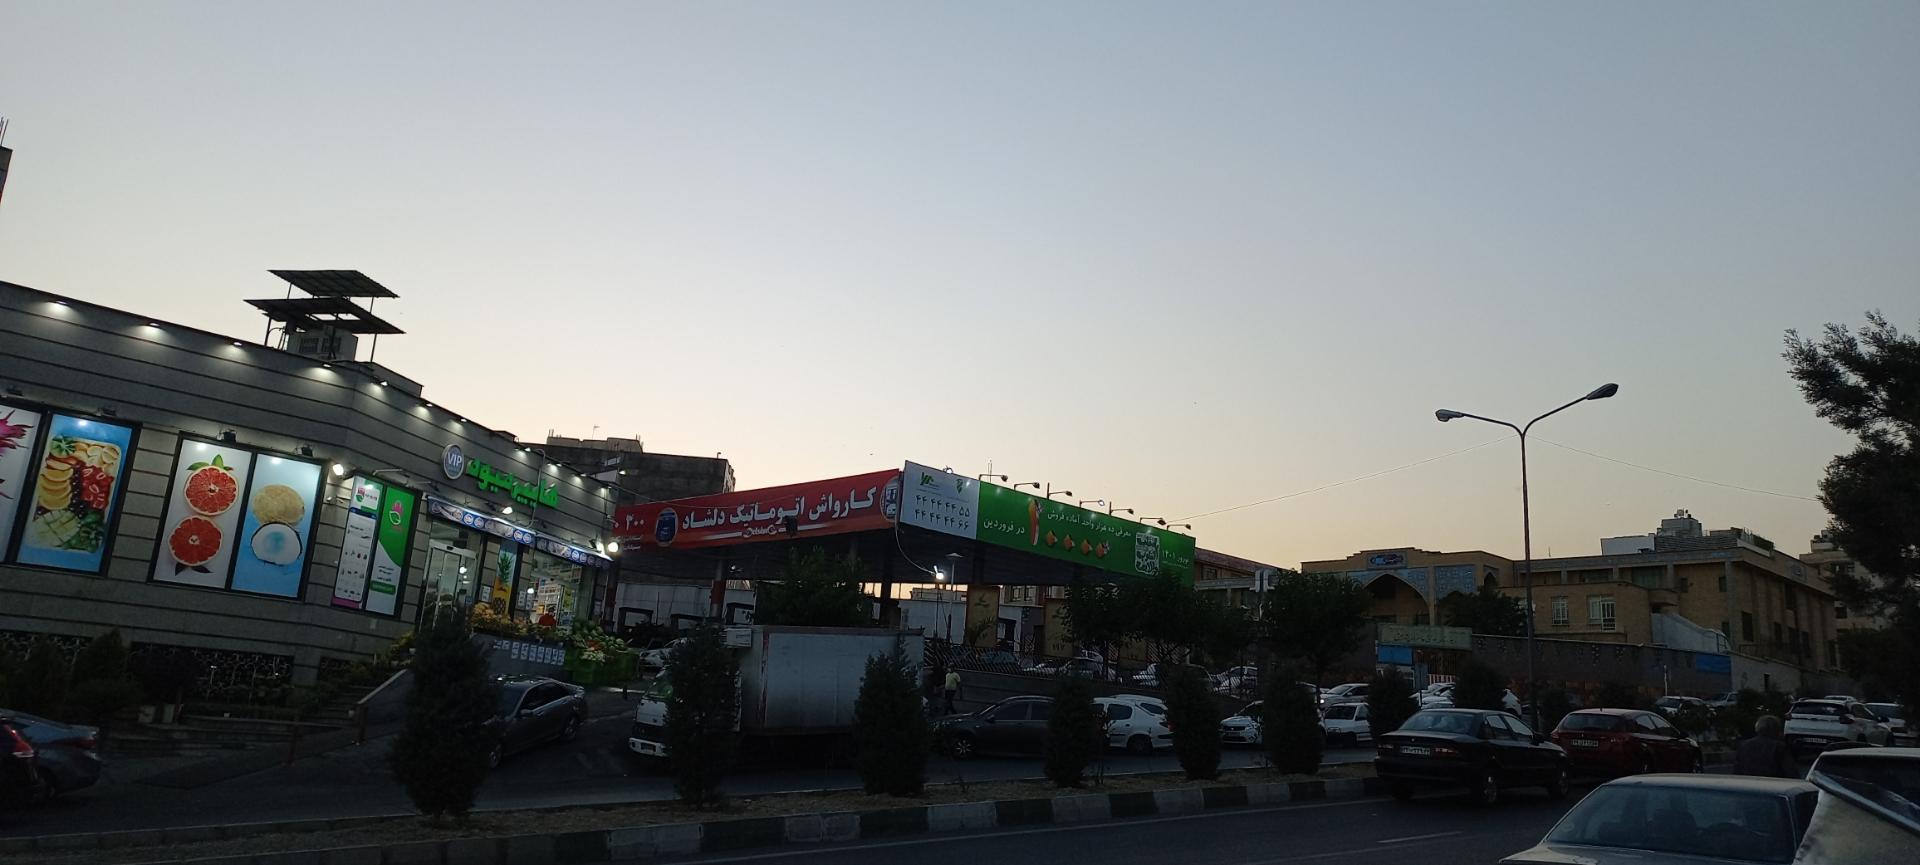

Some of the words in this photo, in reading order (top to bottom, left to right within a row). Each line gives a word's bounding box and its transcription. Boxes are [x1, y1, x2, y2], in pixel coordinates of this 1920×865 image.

[448, 452, 462, 467] VIP
[466, 457, 513, 493] میوه
[511, 479, 560, 509] هایپر
[809, 487, 877, 520] کارواش
[730, 496, 805, 527] اتوماتیک
[916, 494, 928, 506] ۴۴
[930, 498, 942, 510] ۴۴
[945, 502, 957, 513] ۴۴
[958, 506, 970, 517] ۵۵
[1047, 510, 1065, 520] فروش
[682, 508, 725, 529] دلشاد
[915, 509, 926, 521] ۴۴
[929, 512, 941, 525] ۴۴
[944, 516, 955, 528] ۴۴
[983, 518, 1014, 533] فروردین
[1014, 525, 1025, 534] در
